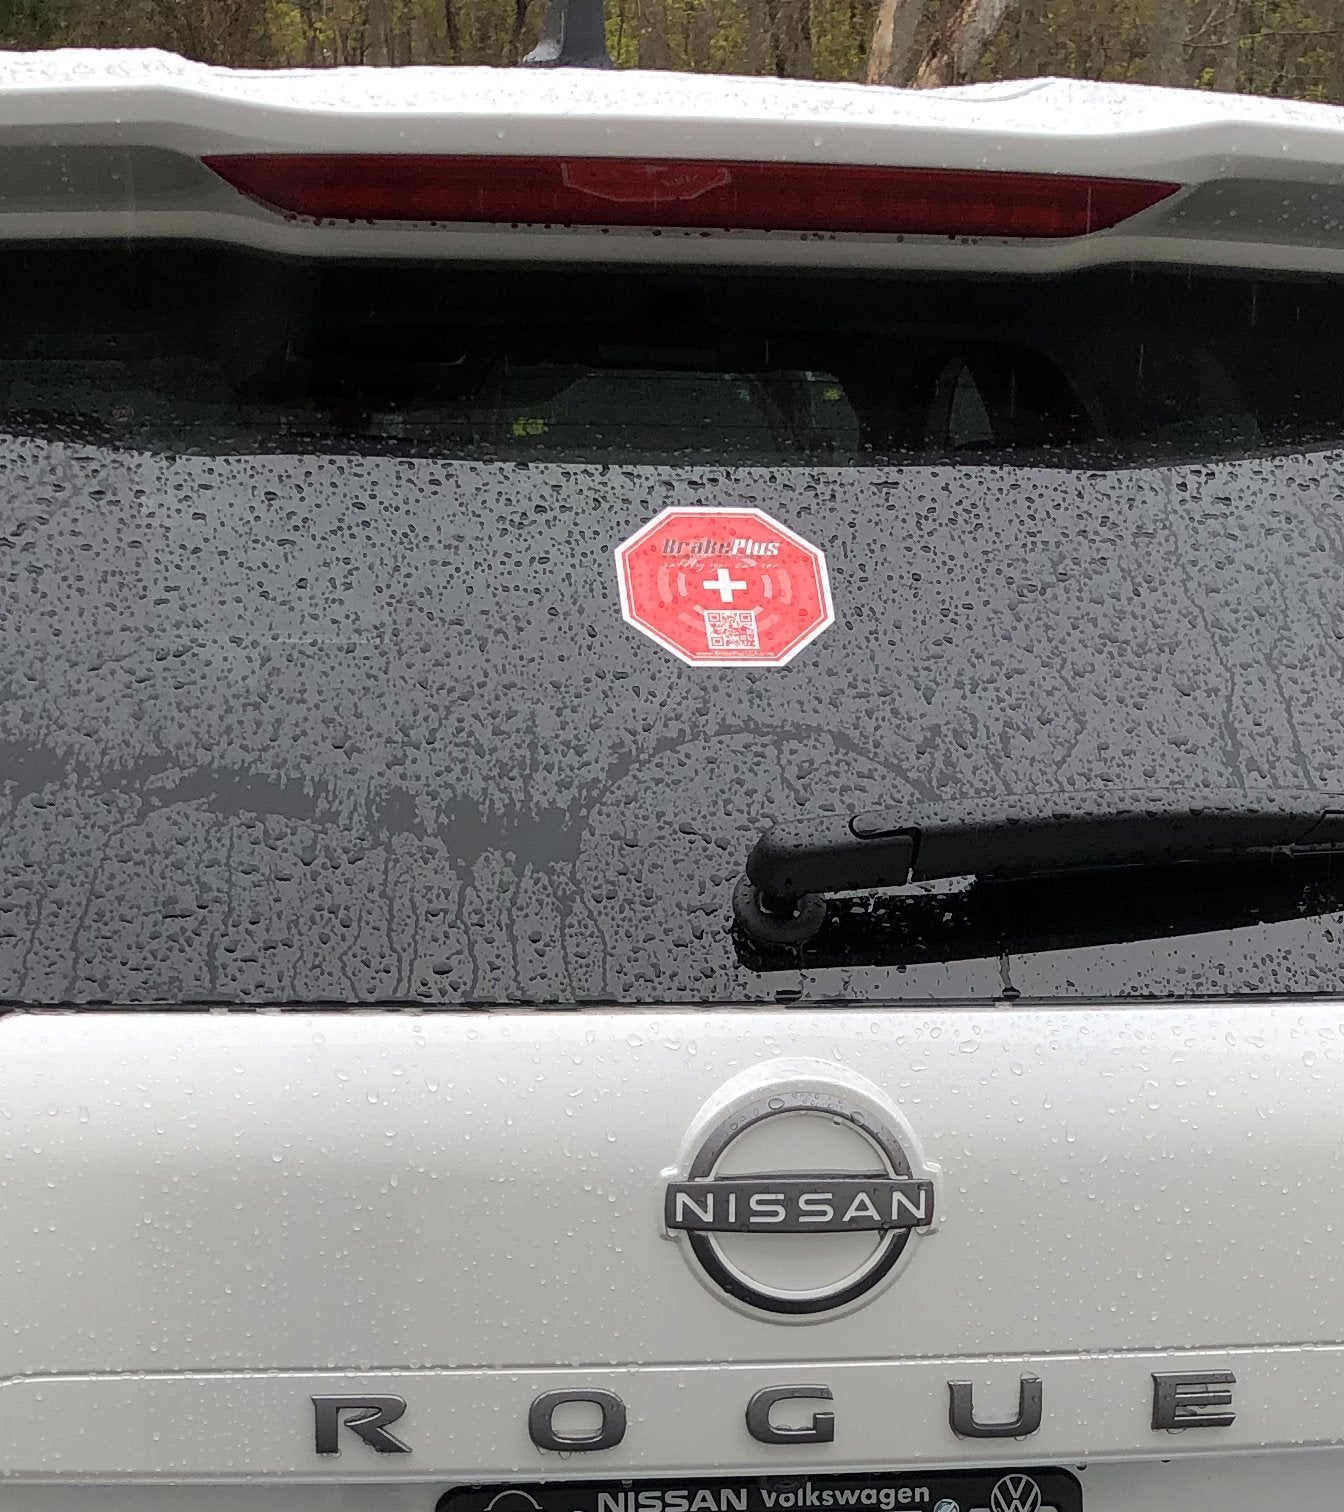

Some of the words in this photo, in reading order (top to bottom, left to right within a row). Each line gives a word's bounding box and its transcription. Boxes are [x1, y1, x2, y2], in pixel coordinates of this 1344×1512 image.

[662, 537, 781, 556] BrakePlus
[675, 1189, 916, 1222] NISSAN
[311, 1368, 1237, 1454] ROGUE
[760, 1482, 930, 1510] Volkswagen
